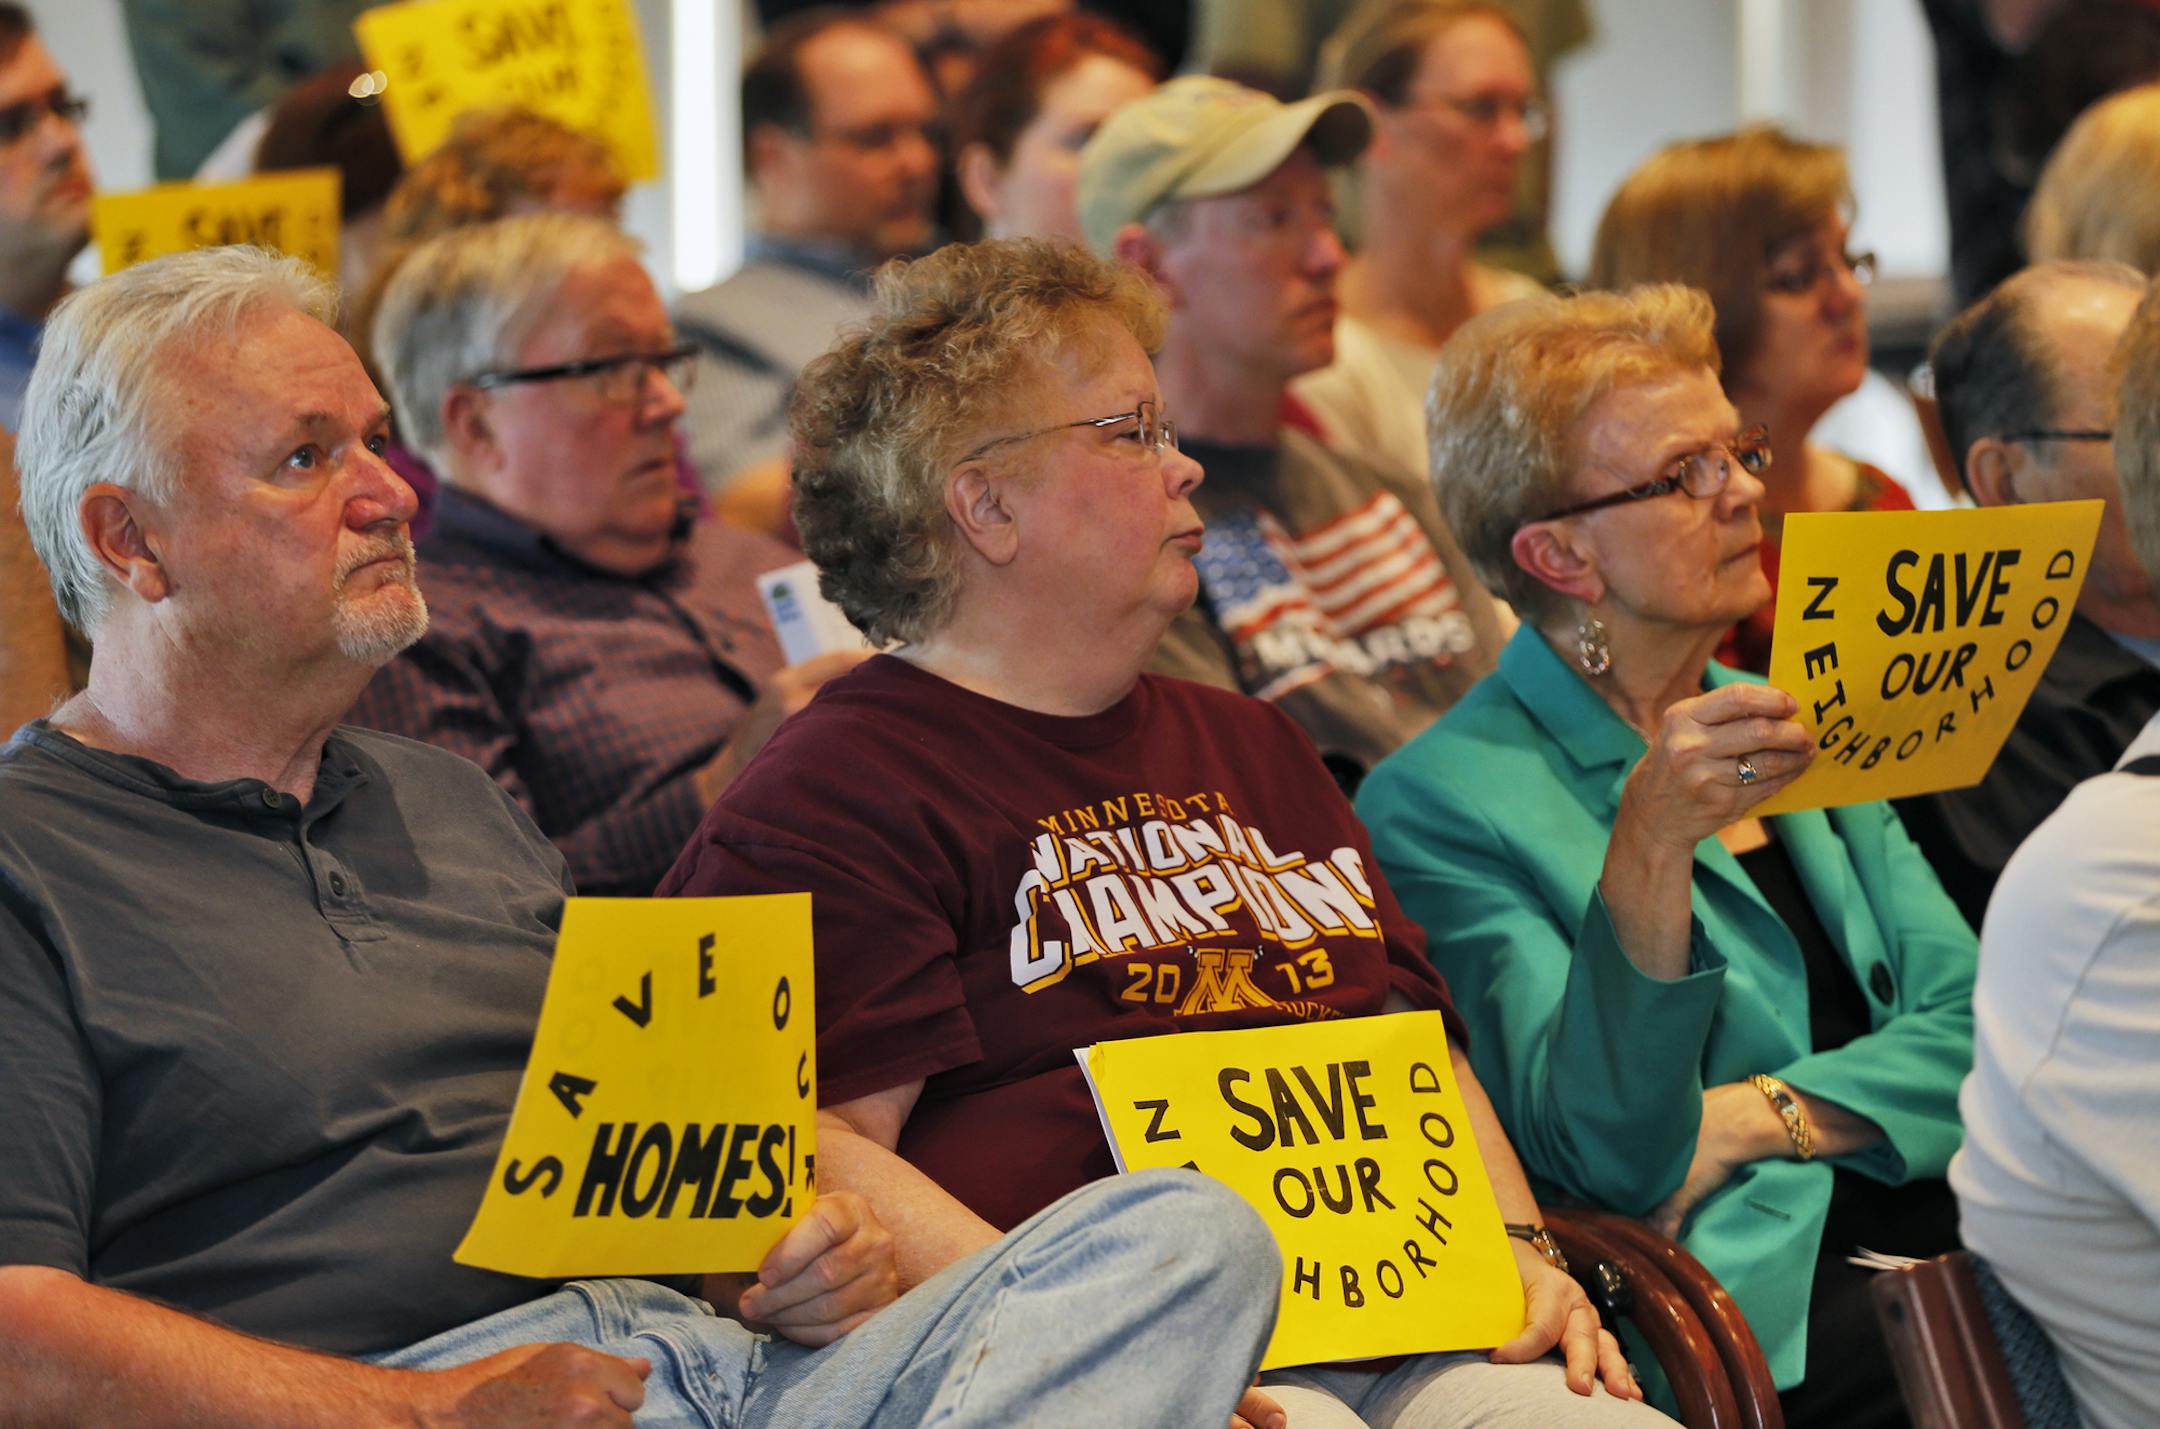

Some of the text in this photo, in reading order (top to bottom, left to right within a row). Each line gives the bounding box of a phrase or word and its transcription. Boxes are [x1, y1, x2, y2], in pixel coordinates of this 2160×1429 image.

[456, 0, 582, 72] SAVE
[1876, 550, 2021, 637] SAVE
[1803, 550, 2075, 770] NEIGHBORHOOD
[1880, 643, 1978, 700] OUR
[1030, 813, 1306, 890] NATIONAL
[1037, 791, 1236, 836] MINNESOTA
[1121, 962, 1181, 1004] 20
[1275, 947, 1335, 995] 13
[504, 933, 717, 1198] SAVE
[1218, 1060, 1388, 1151] SAVE
[573, 1122, 796, 1218] HOMES!
[1133, 1062, 1458, 1308] NHBORHOOD
[1273, 1157, 1396, 1218] OUR
